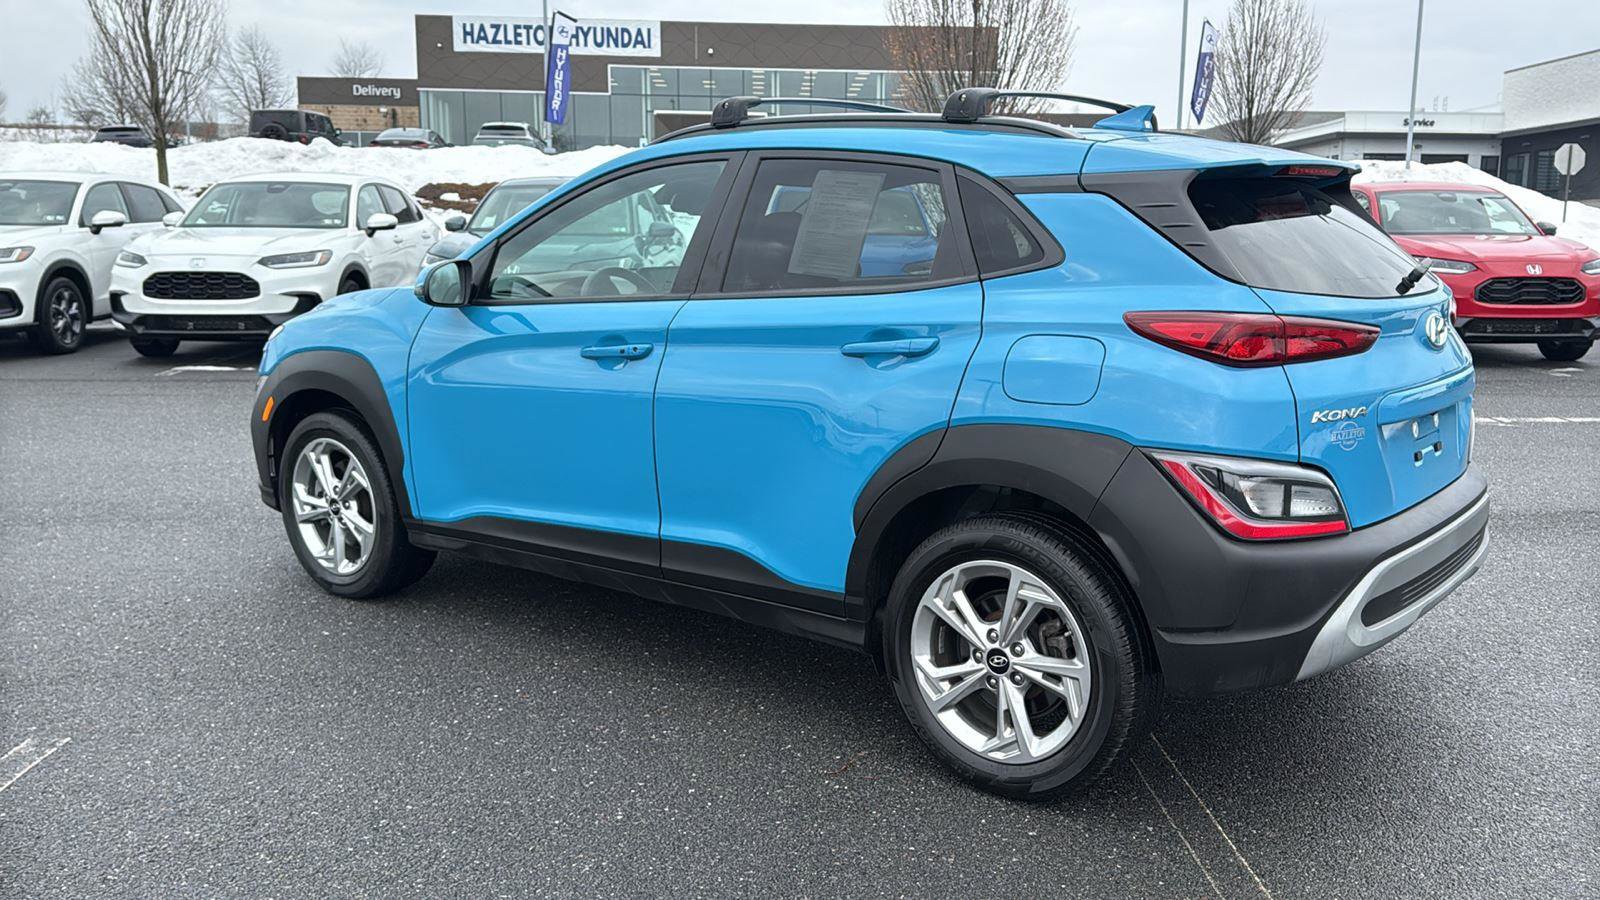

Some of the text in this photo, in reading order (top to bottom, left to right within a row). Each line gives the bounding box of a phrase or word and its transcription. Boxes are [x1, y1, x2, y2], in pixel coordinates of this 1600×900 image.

[462, 22, 653, 49] HAZLETO HYUNDAI
[352, 84, 401, 99] Delivery
[551, 47, 567, 121] HYUNDAI
[1194, 55, 1213, 115] HYUNDA
[1403, 118, 1435, 127] Srvice
[1310, 406, 1368, 424] KONA
